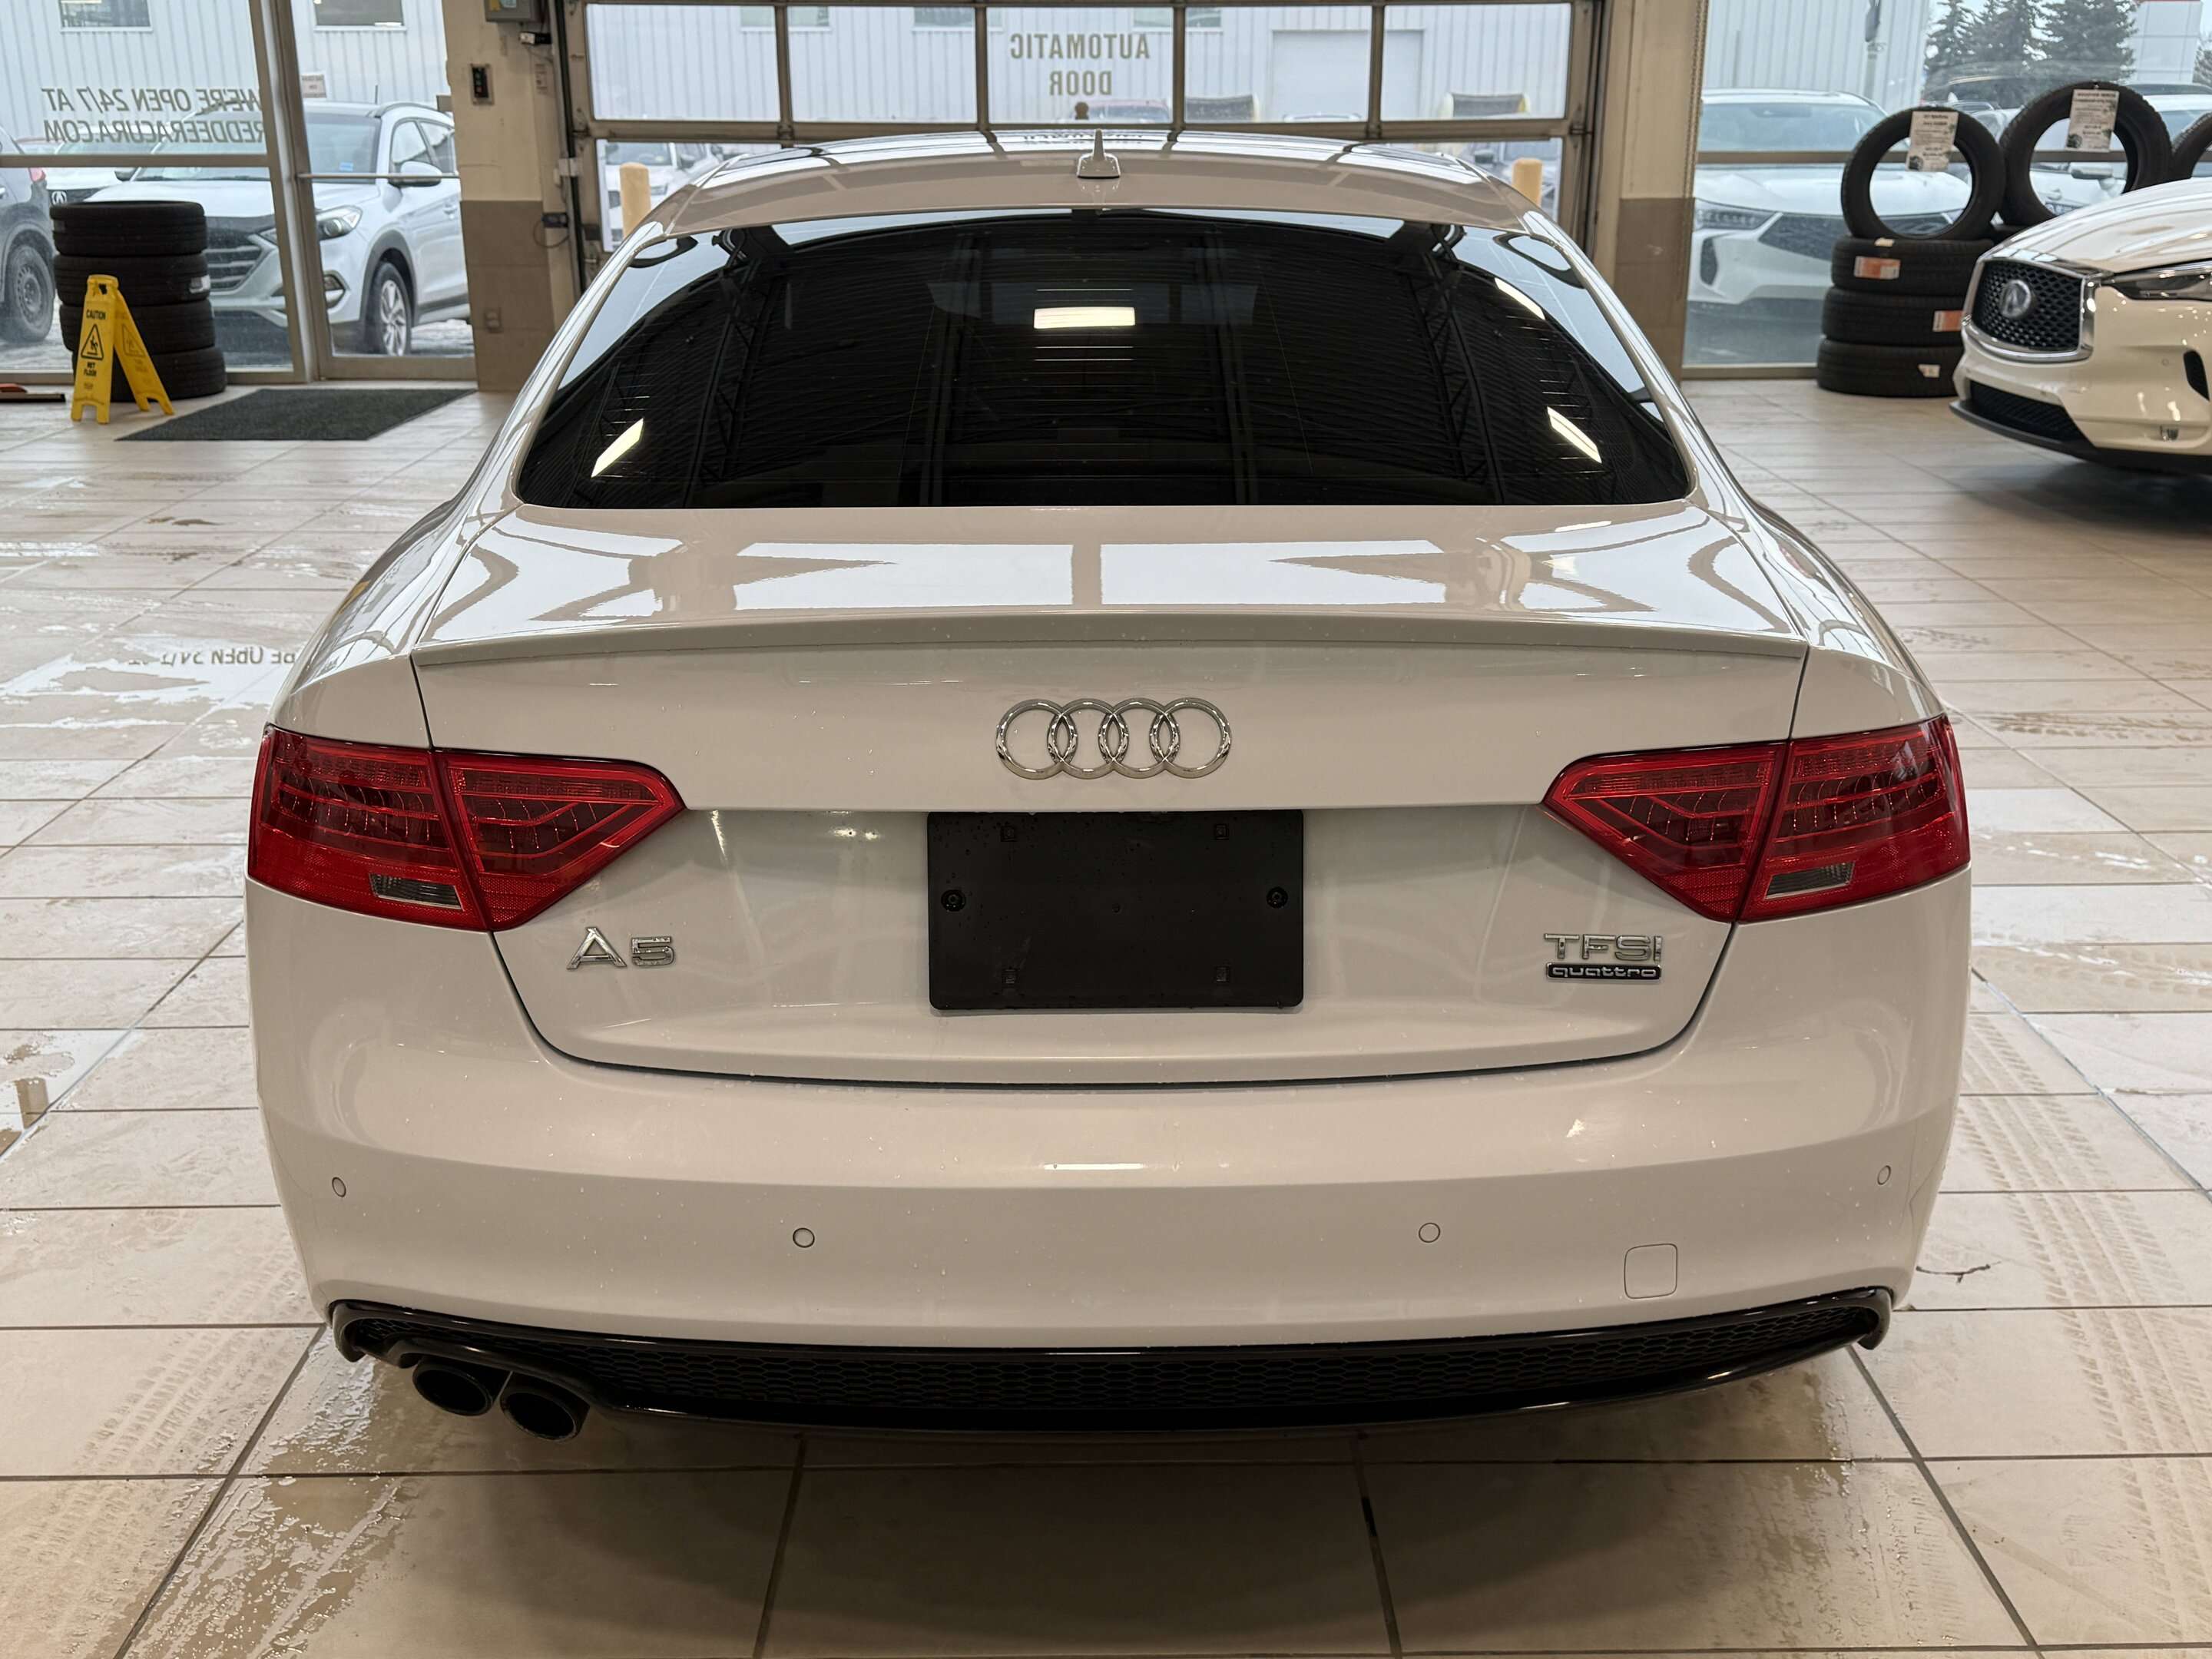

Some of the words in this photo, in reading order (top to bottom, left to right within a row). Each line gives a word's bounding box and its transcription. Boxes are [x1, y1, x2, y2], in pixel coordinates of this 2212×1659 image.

[86, 310, 106, 320] CAUTION
[566, 926, 675, 970] A5
[1544, 933, 1663, 962] TFSI
[1551, 965, 1657, 979] quattro
